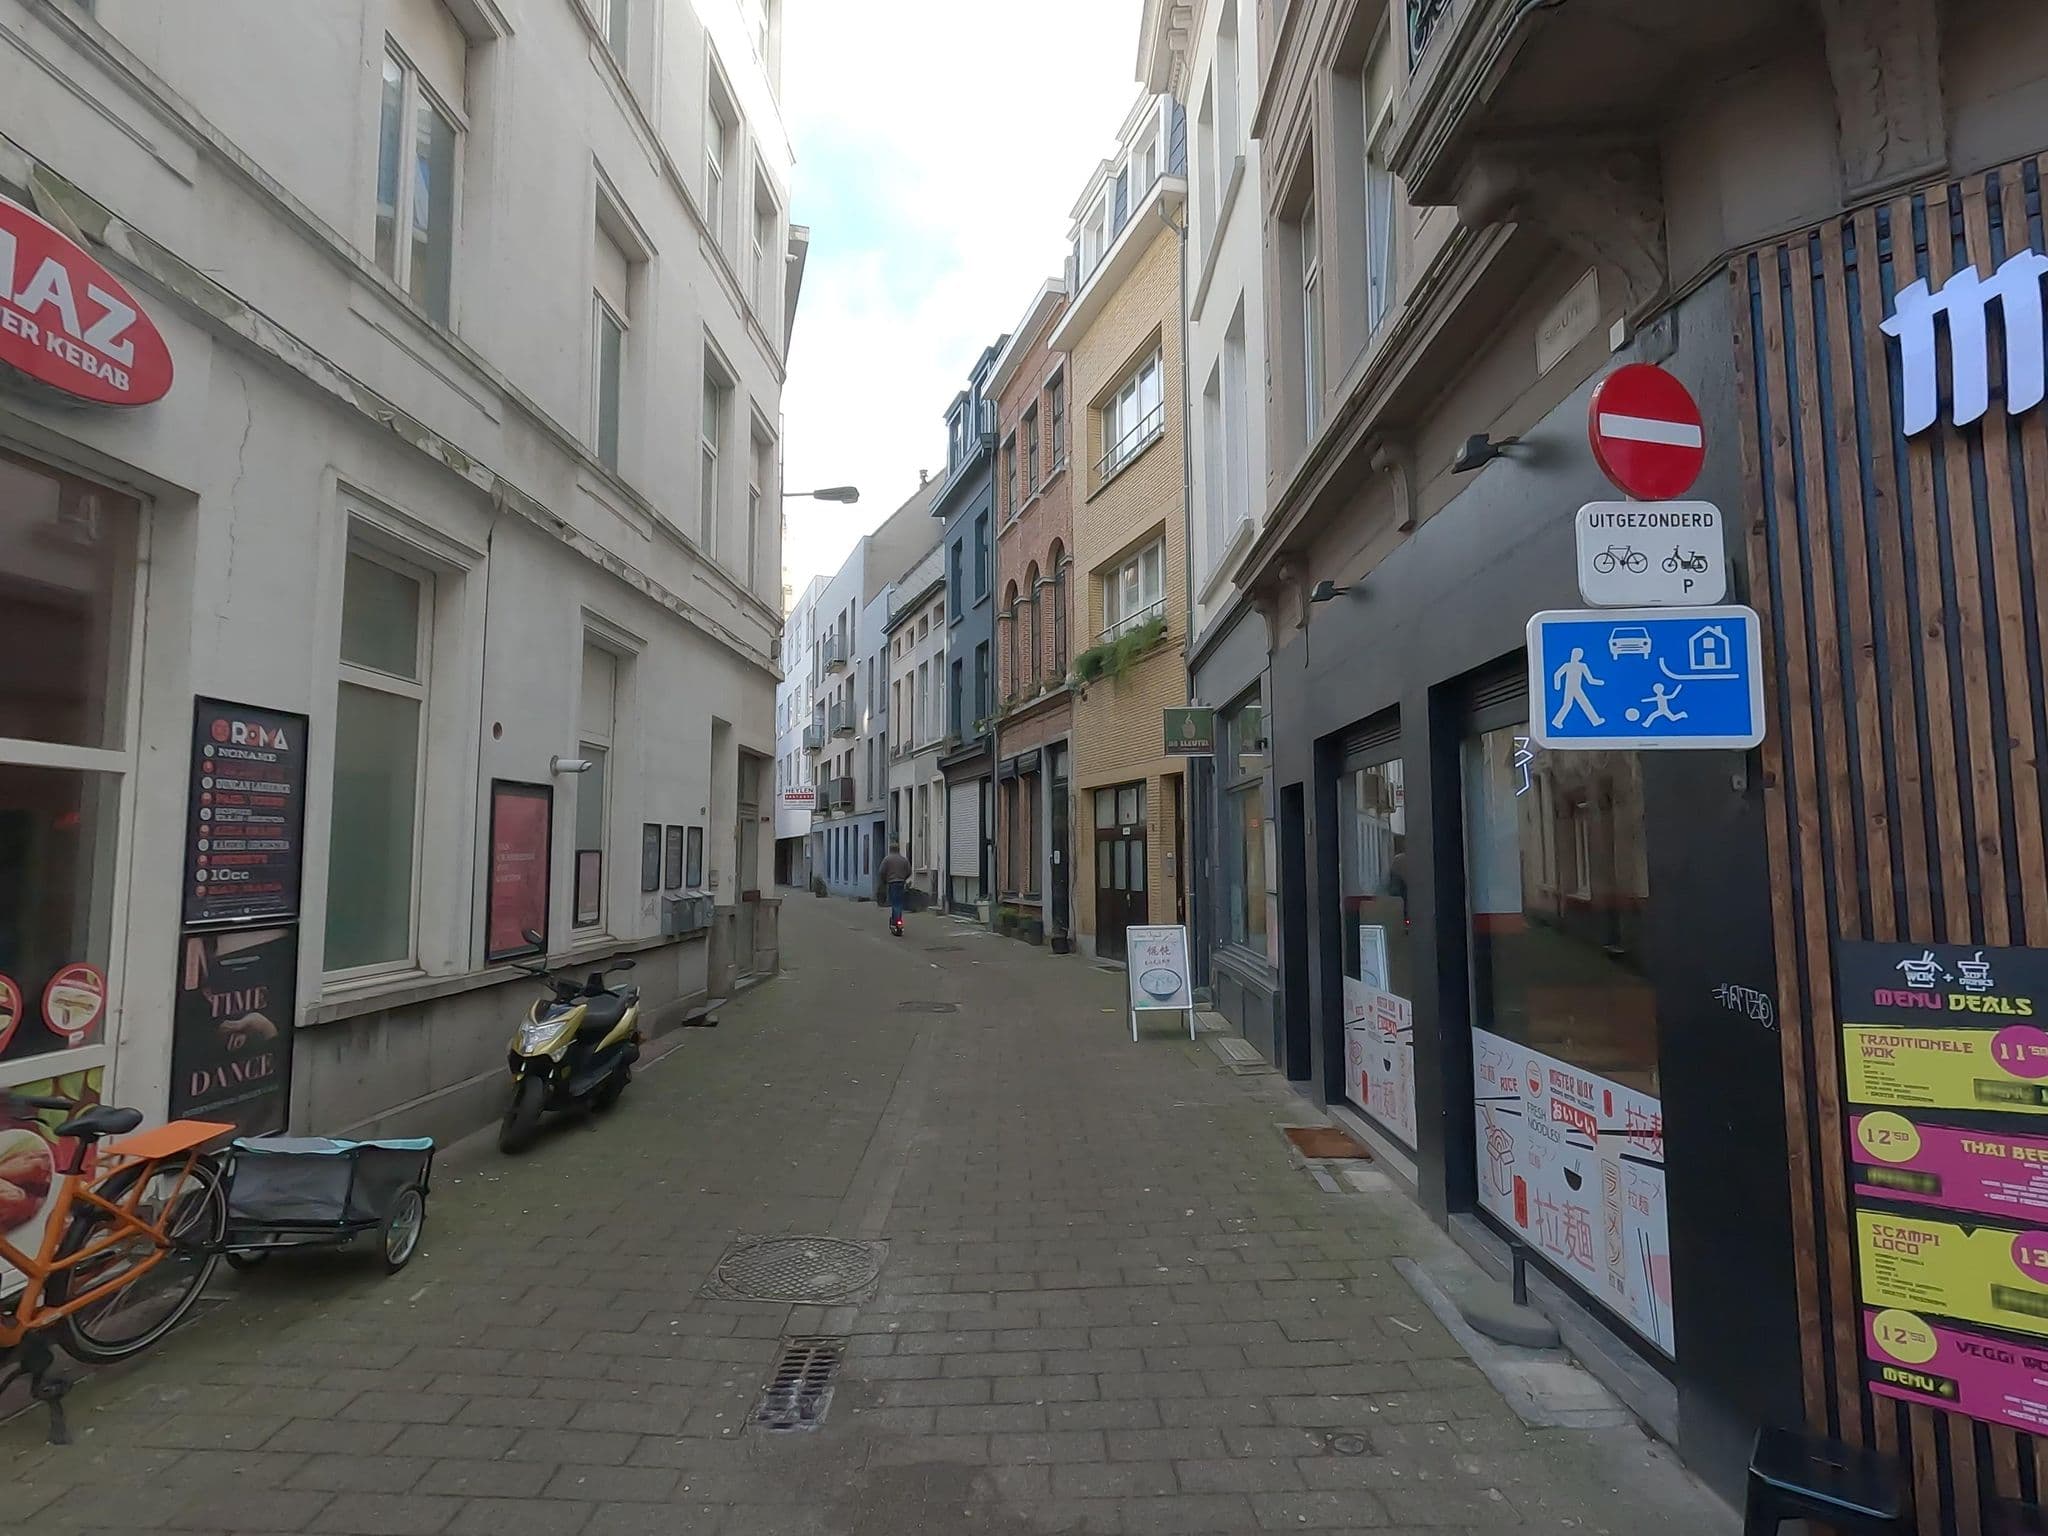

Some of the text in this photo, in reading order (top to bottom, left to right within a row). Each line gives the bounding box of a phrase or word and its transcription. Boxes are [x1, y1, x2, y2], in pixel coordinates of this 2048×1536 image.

[47, 331, 130, 391] KEBAB
[1589, 513, 1713, 528] UITGEZONDERD
[1683, 579, 1694, 594] P
[211, 869, 250, 881] 10cc
[1906, 971, 1936, 982] WOK
[208, 985, 268, 1018] TIME
[1874, 989, 2033, 1016] MENU DEALS
[1859, 1033, 1974, 1054] TRADITIONELE
[1861, 1047, 1896, 1059] WOK
[191, 1053, 274, 1096] DANCE
[1500, 1076, 1518, 1092] RICE
[1552, 1100, 1596, 1137] おいしい
[1960, 1140, 2006, 1157] THAI
[1872, 1224, 1940, 1247] SCAMPI
[1873, 1237, 1919, 1256] LOCO
[1955, 1340, 2014, 1364] VEGGI
[1883, 1366, 1935, 1392] MENU
